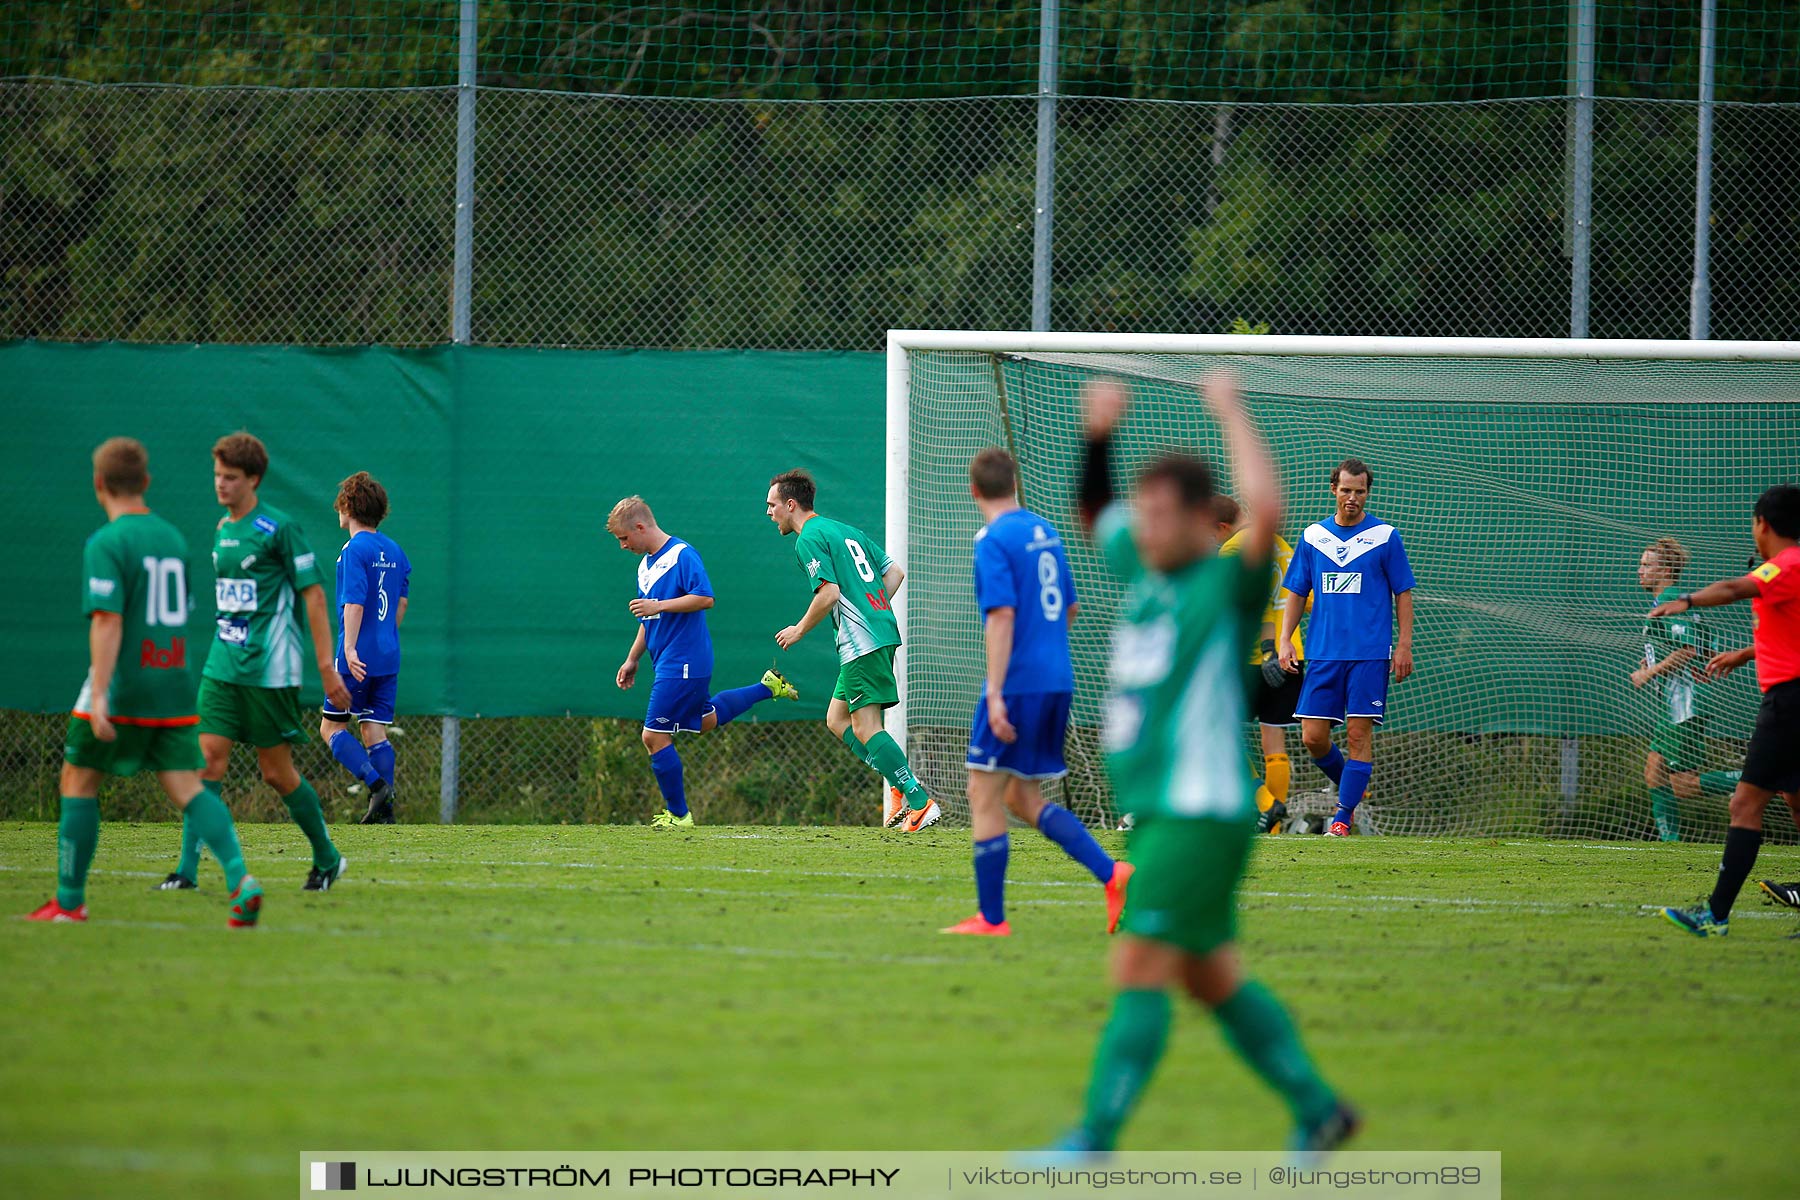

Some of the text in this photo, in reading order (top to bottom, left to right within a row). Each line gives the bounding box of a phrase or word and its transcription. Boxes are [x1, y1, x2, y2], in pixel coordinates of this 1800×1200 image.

[845, 538, 875, 583] 8
[1037, 550, 1063, 622] 8
[142, 556, 187, 627] 10
[141, 635, 187, 670] Roll
